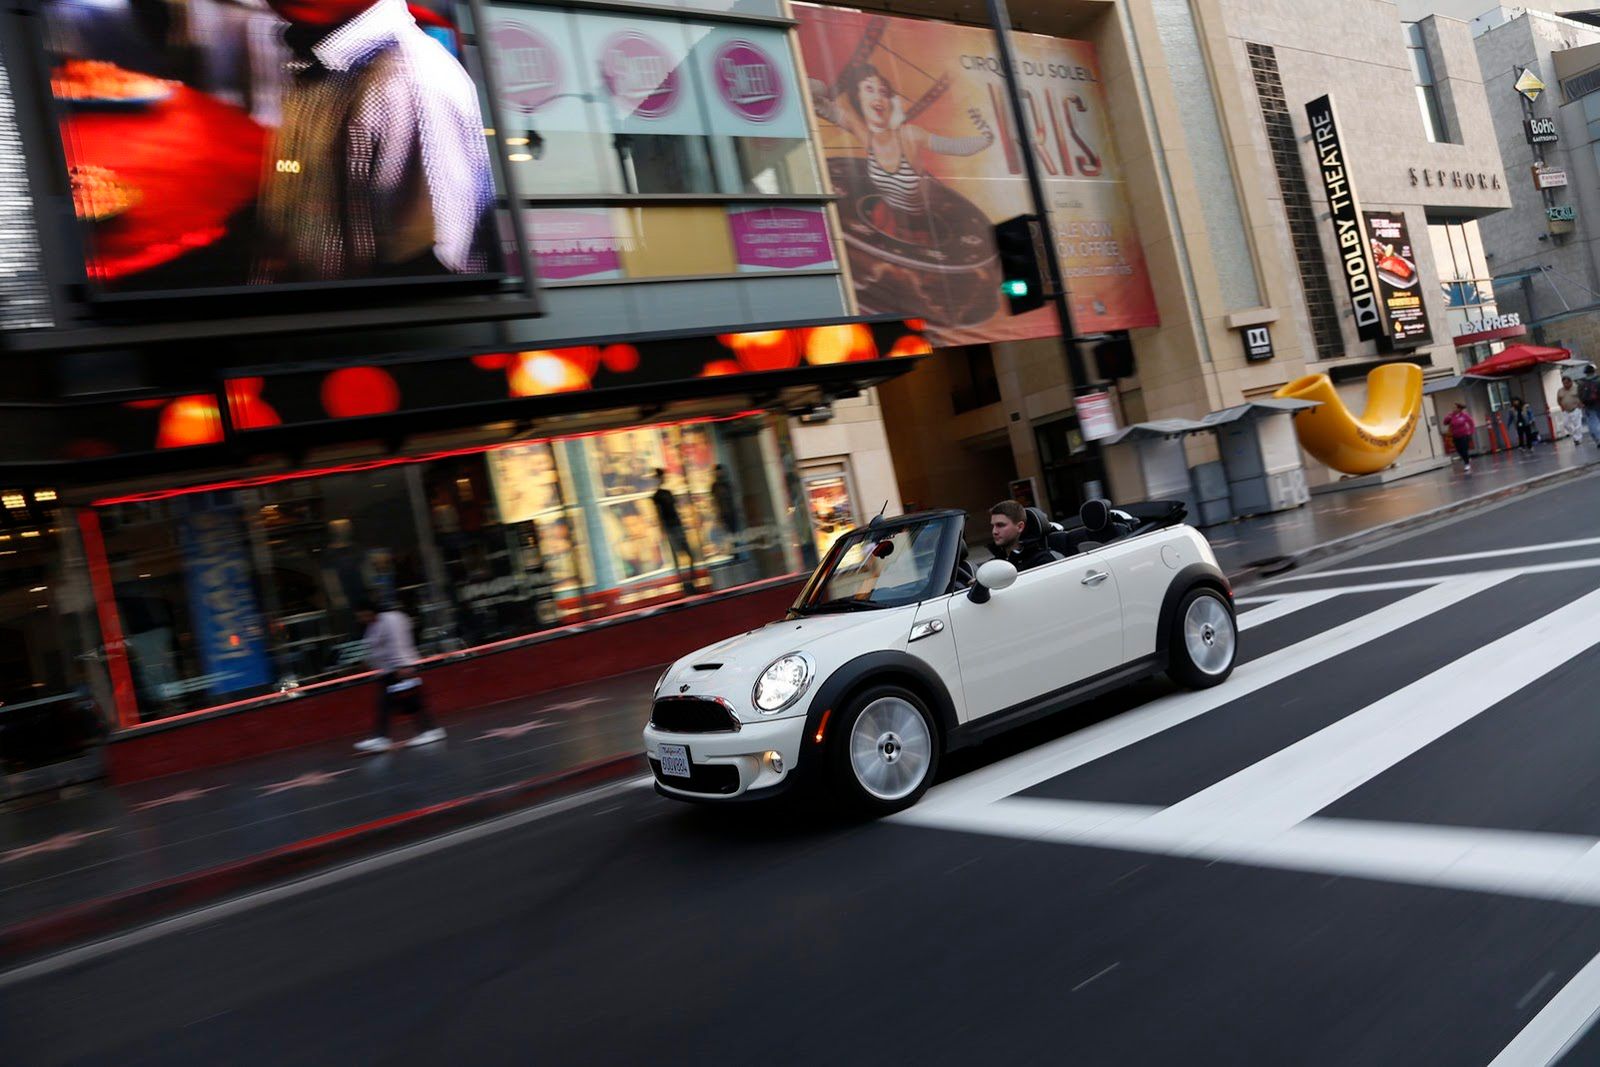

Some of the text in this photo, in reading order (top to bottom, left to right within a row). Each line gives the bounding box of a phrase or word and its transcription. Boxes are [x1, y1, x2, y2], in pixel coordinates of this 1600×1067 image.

[960, 55, 1099, 82] CIRQE DU SOLEIL
[986, 82, 1102, 176] IRIS
[1530, 118, 1555, 134] BoHo
[1409, 167, 1500, 190] SEPHORA
[1312, 111, 1369, 292] DOLBY THEATRE
[1461, 312, 1520, 334] EXPRESS
